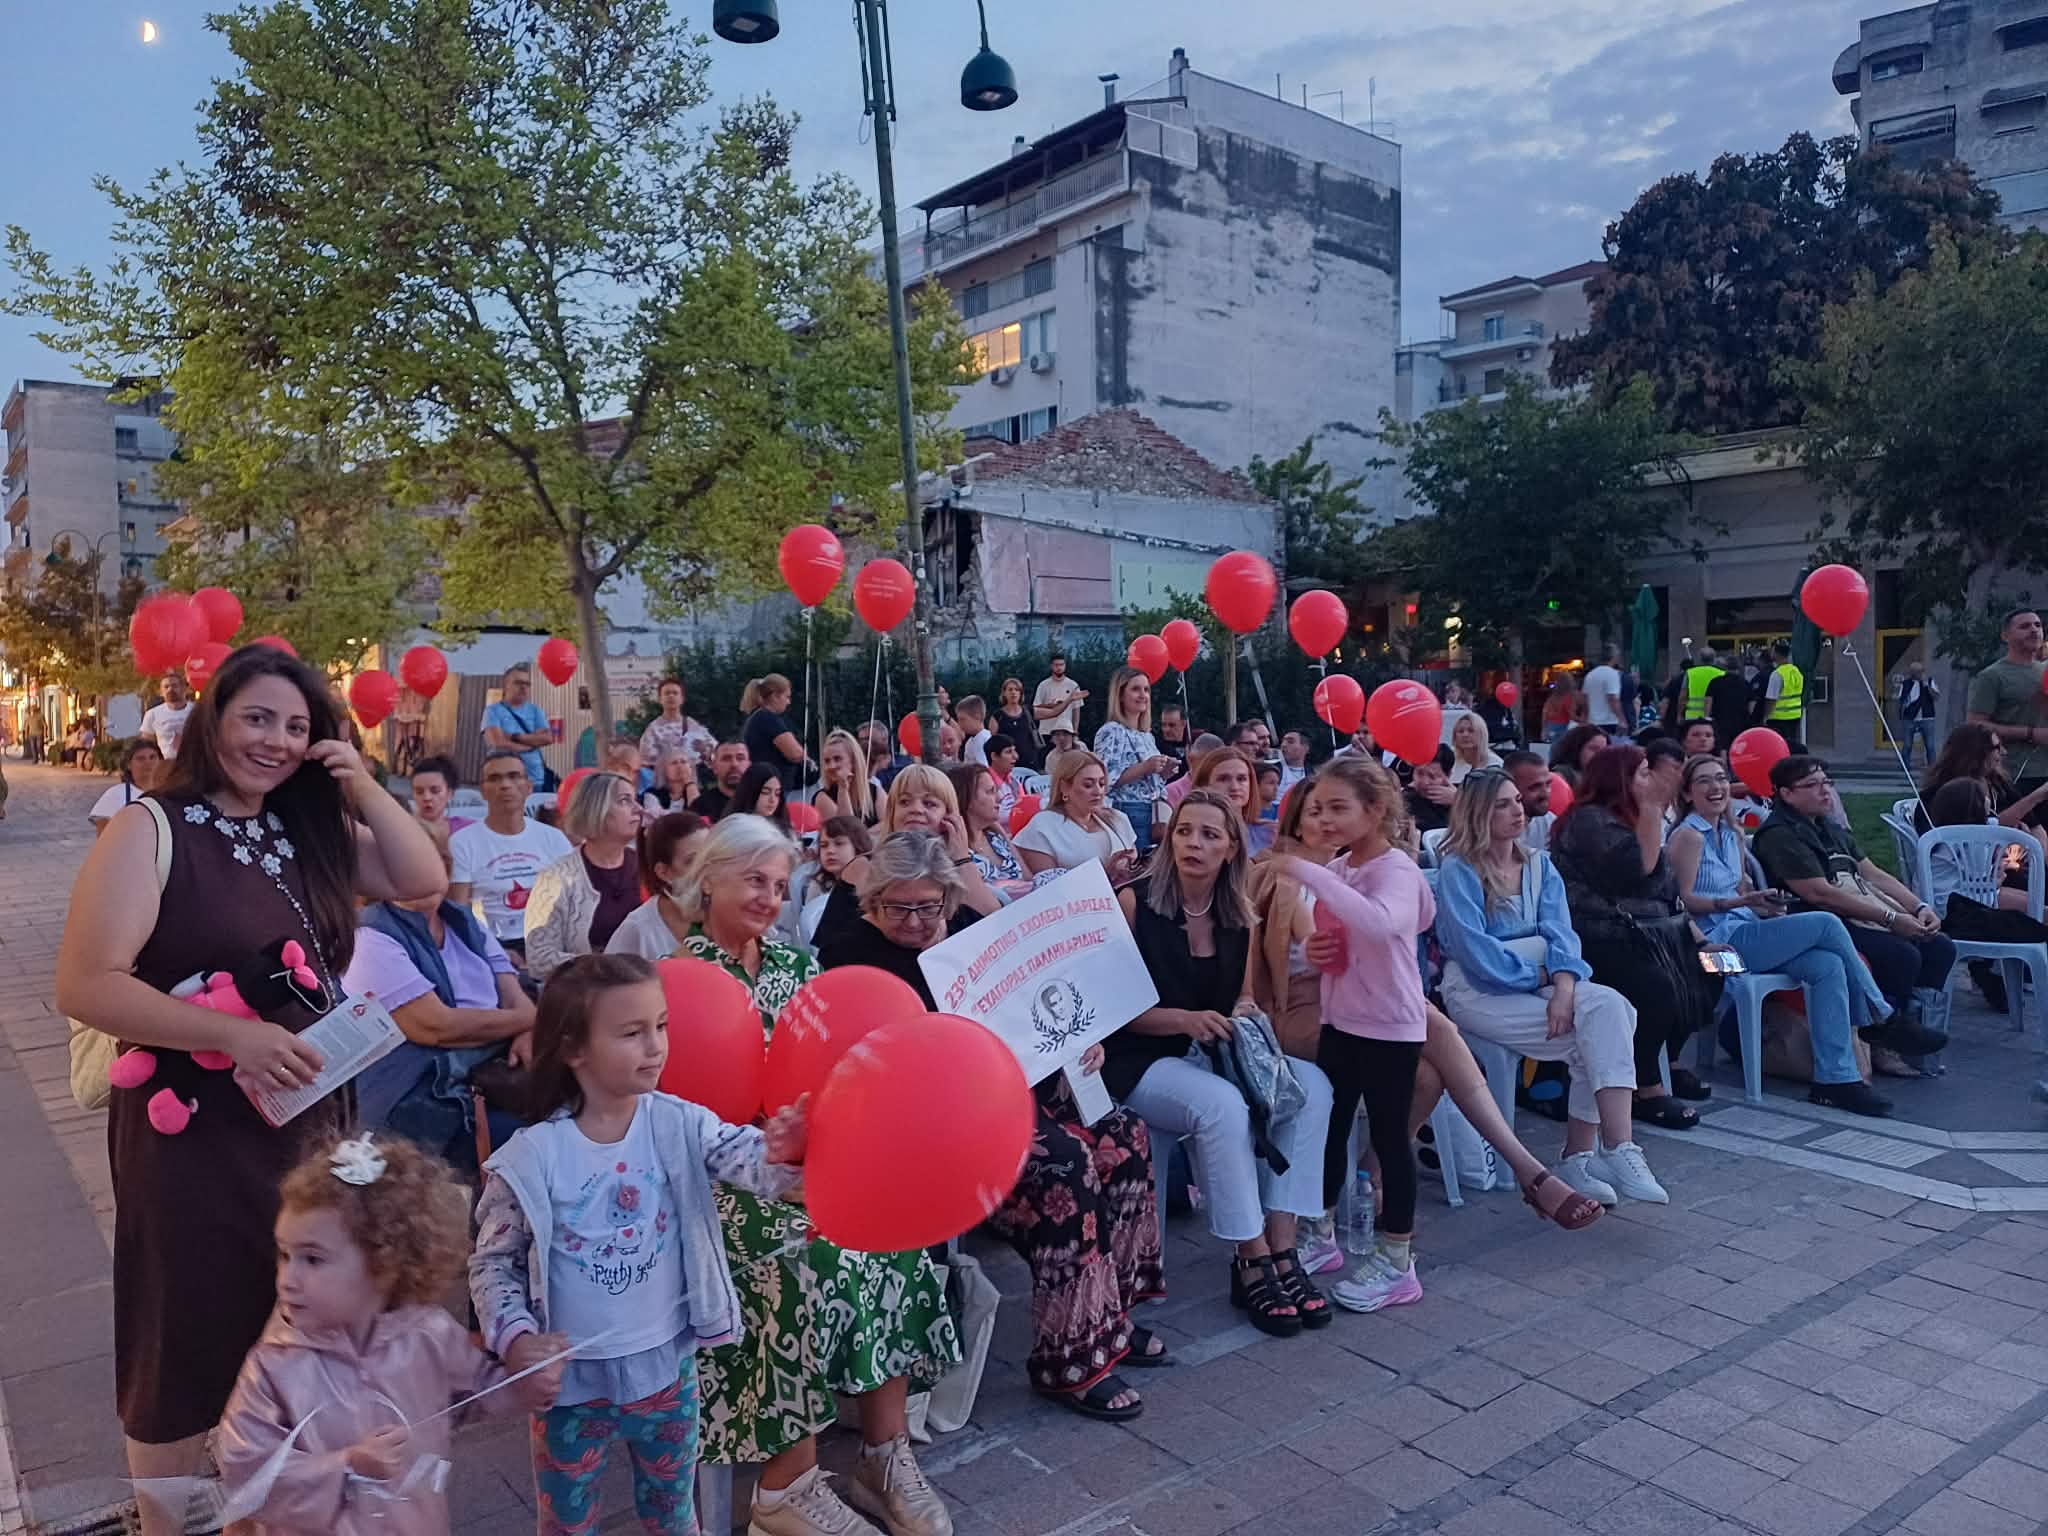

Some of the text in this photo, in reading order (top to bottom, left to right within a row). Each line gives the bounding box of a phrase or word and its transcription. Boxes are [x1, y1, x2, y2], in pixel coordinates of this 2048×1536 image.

[968, 929, 1018, 983] ΔΗΜΟΤΙΚΟ
[1019, 905, 1065, 937] ΣΧΟΛΕΙΟ
[1066, 897, 1113, 915] ΛΑΡΙΣΑΣ
